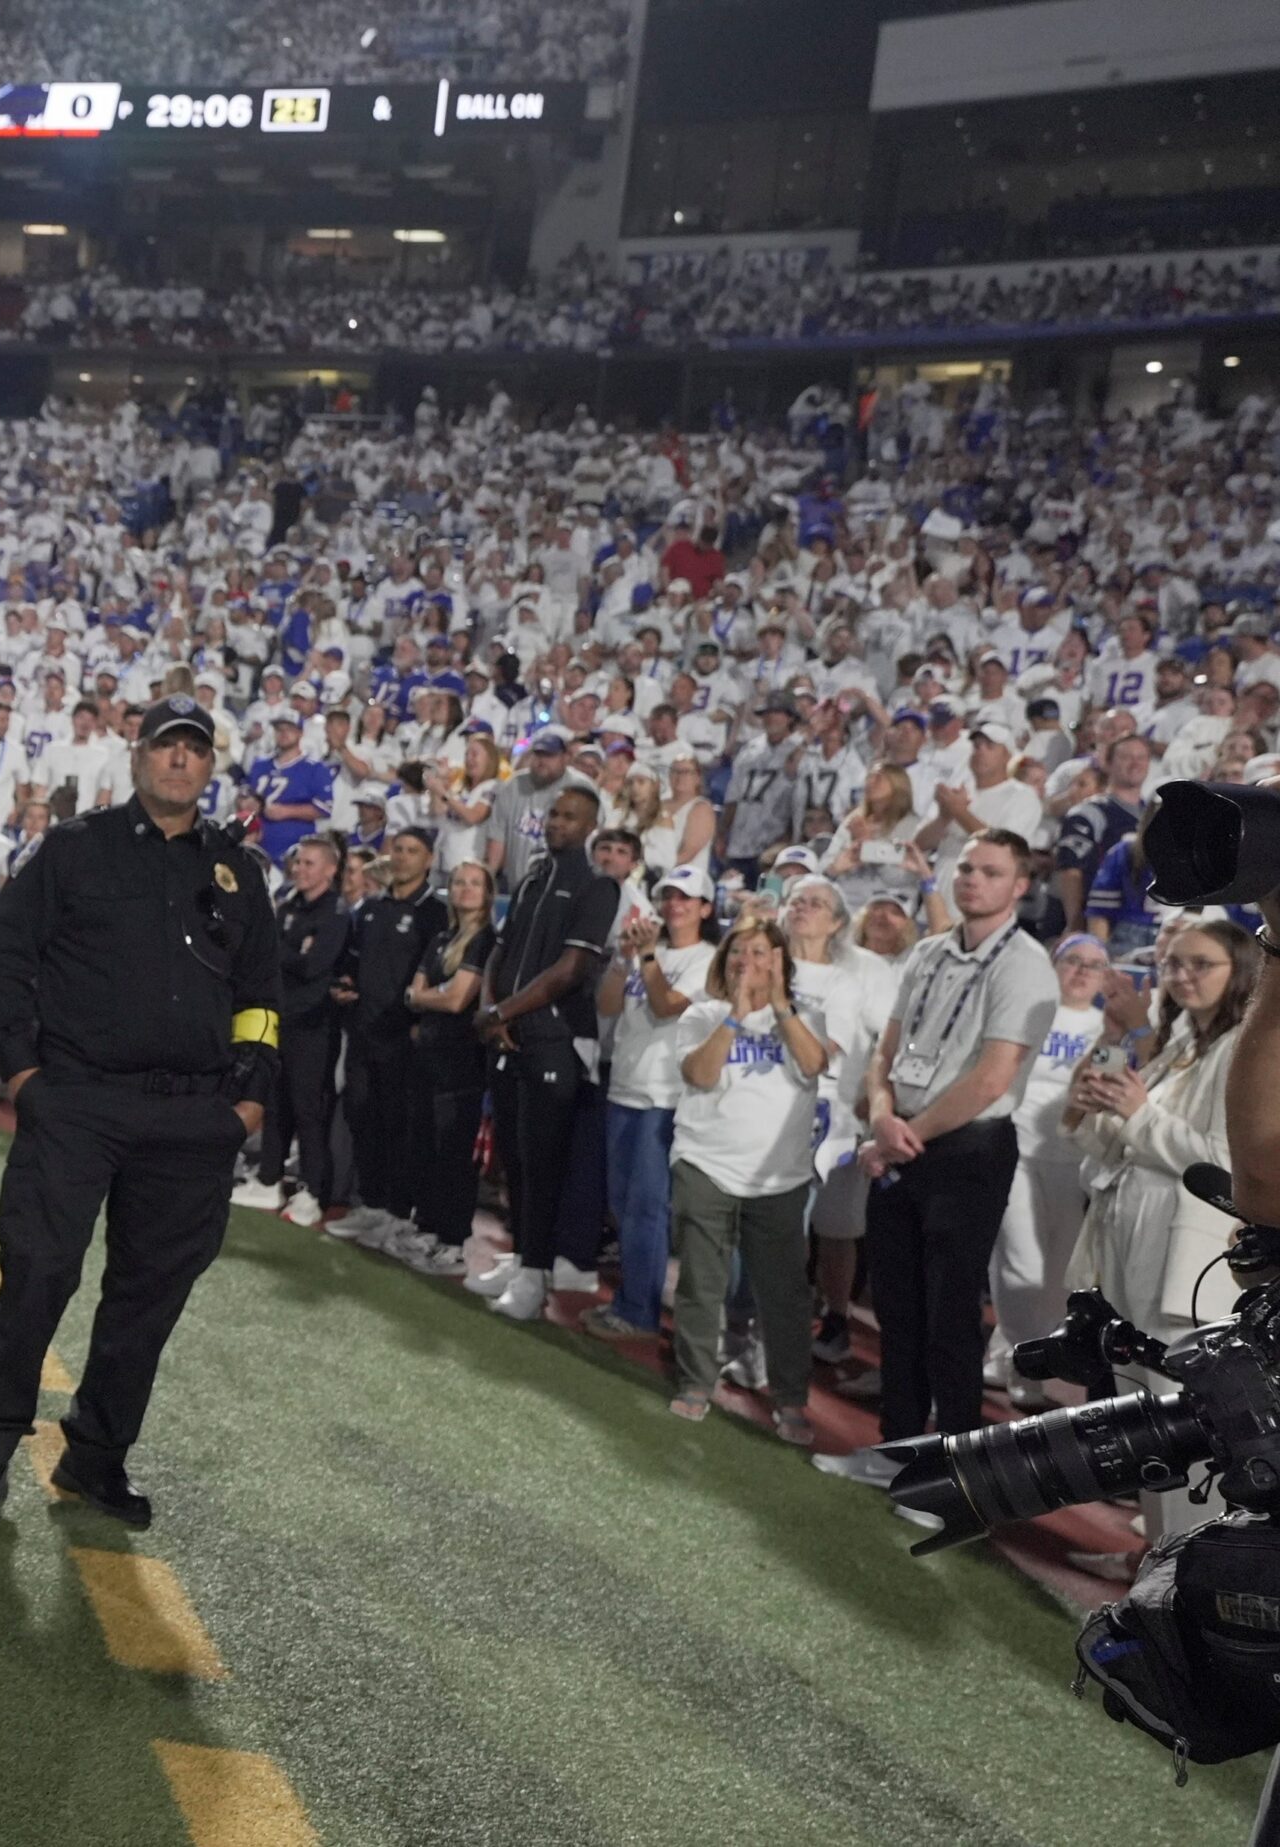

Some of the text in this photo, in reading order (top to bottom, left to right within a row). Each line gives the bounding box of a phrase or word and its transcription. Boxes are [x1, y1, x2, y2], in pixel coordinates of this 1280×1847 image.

[72, 95, 91, 118] 0
[146, 93, 253, 128] 29:06
[272, 98, 316, 123] 25
[456, 93, 544, 120] BALL ON
[1106, 671, 1144, 707] 12
[256, 774, 289, 810] 17
[743, 769, 778, 803] 17
[804, 771, 838, 811] 17
